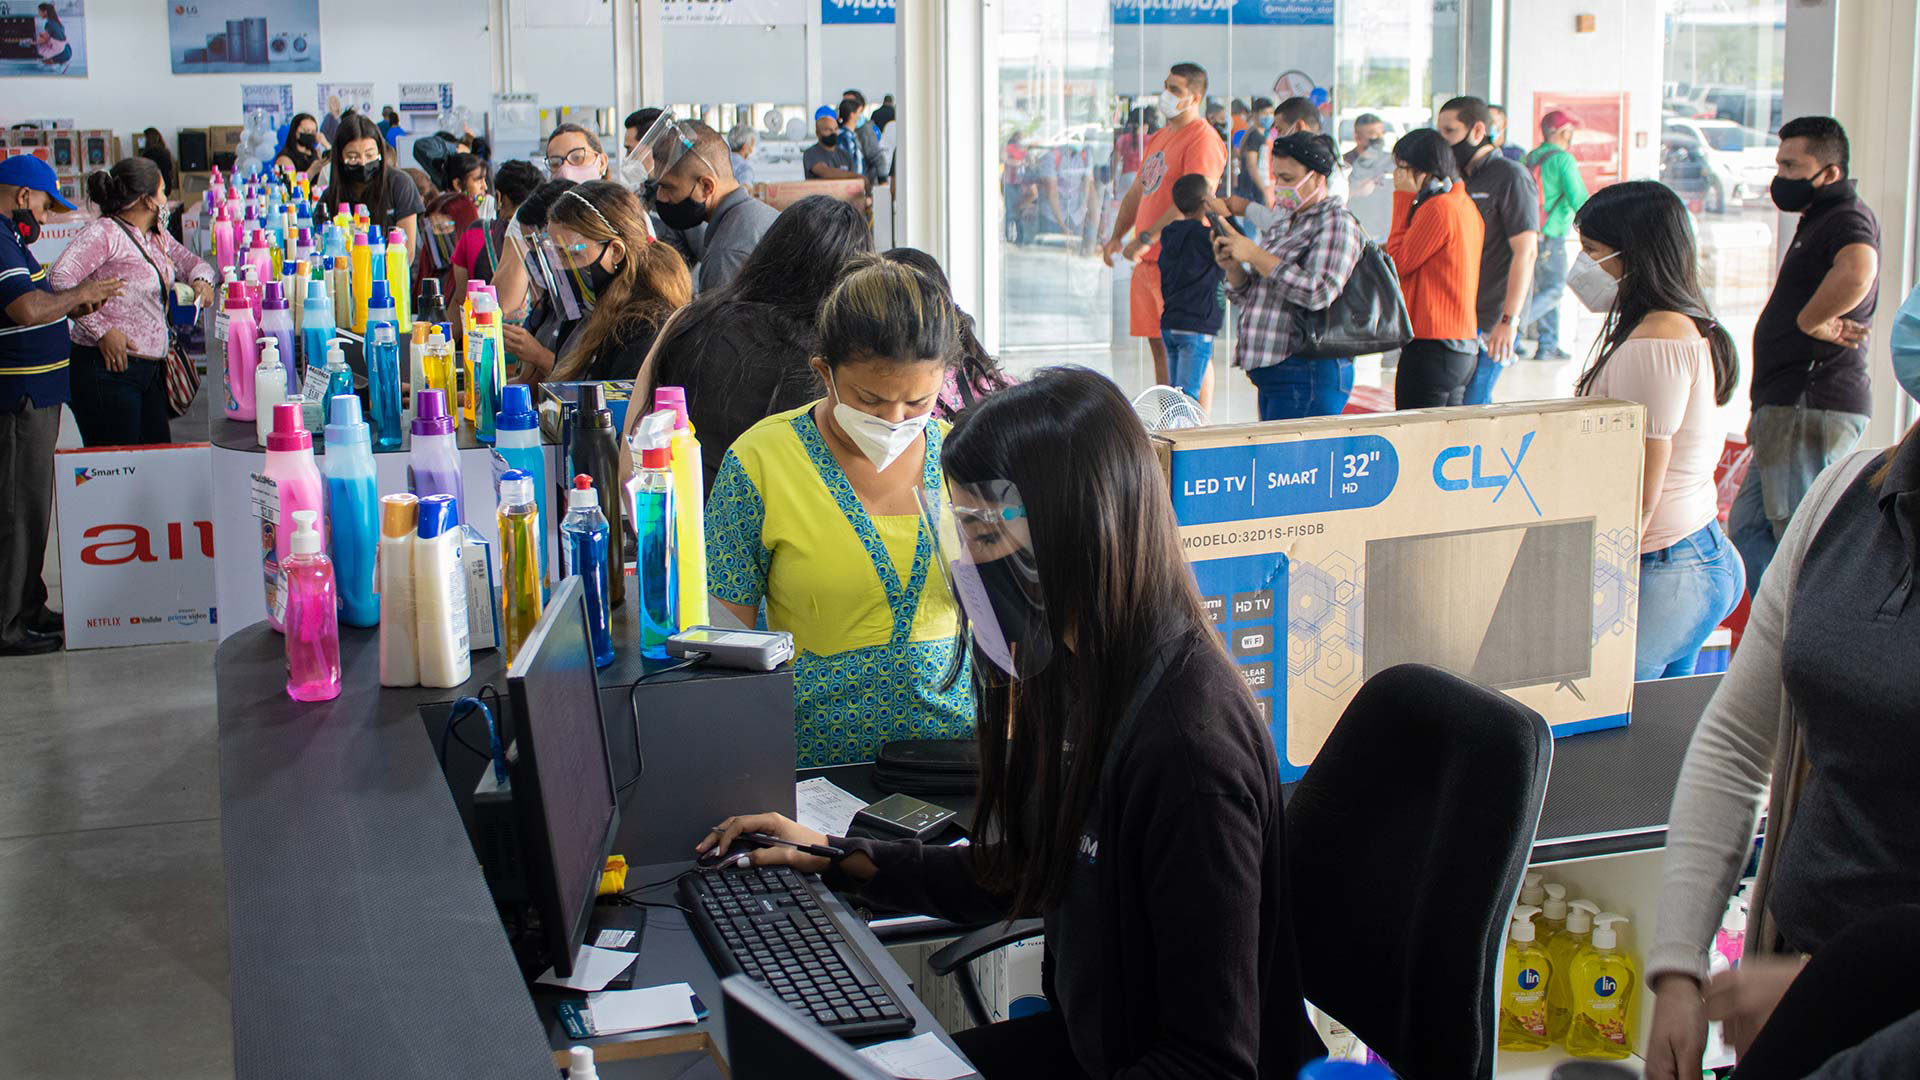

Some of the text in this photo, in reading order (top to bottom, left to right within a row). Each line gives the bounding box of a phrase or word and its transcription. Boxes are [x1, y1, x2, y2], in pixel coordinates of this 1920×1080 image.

[186, 7, 198, 15] LG
[91, 466, 136, 477] Smart TV
[1343, 451, 1380, 478] 32"
[1268, 468, 1319, 489] SMART
[1433, 431, 1542, 517] CLX
[1184, 475, 1247, 496] LED TV
[1342, 483, 1358, 494] HD
[1236, 598, 1271, 613] HD TV
[87, 617, 121, 628] NETFLIX
[188, 612, 208, 620] video
[1526, 968, 1539, 984] lin
[1603, 976, 1616, 991] lin
